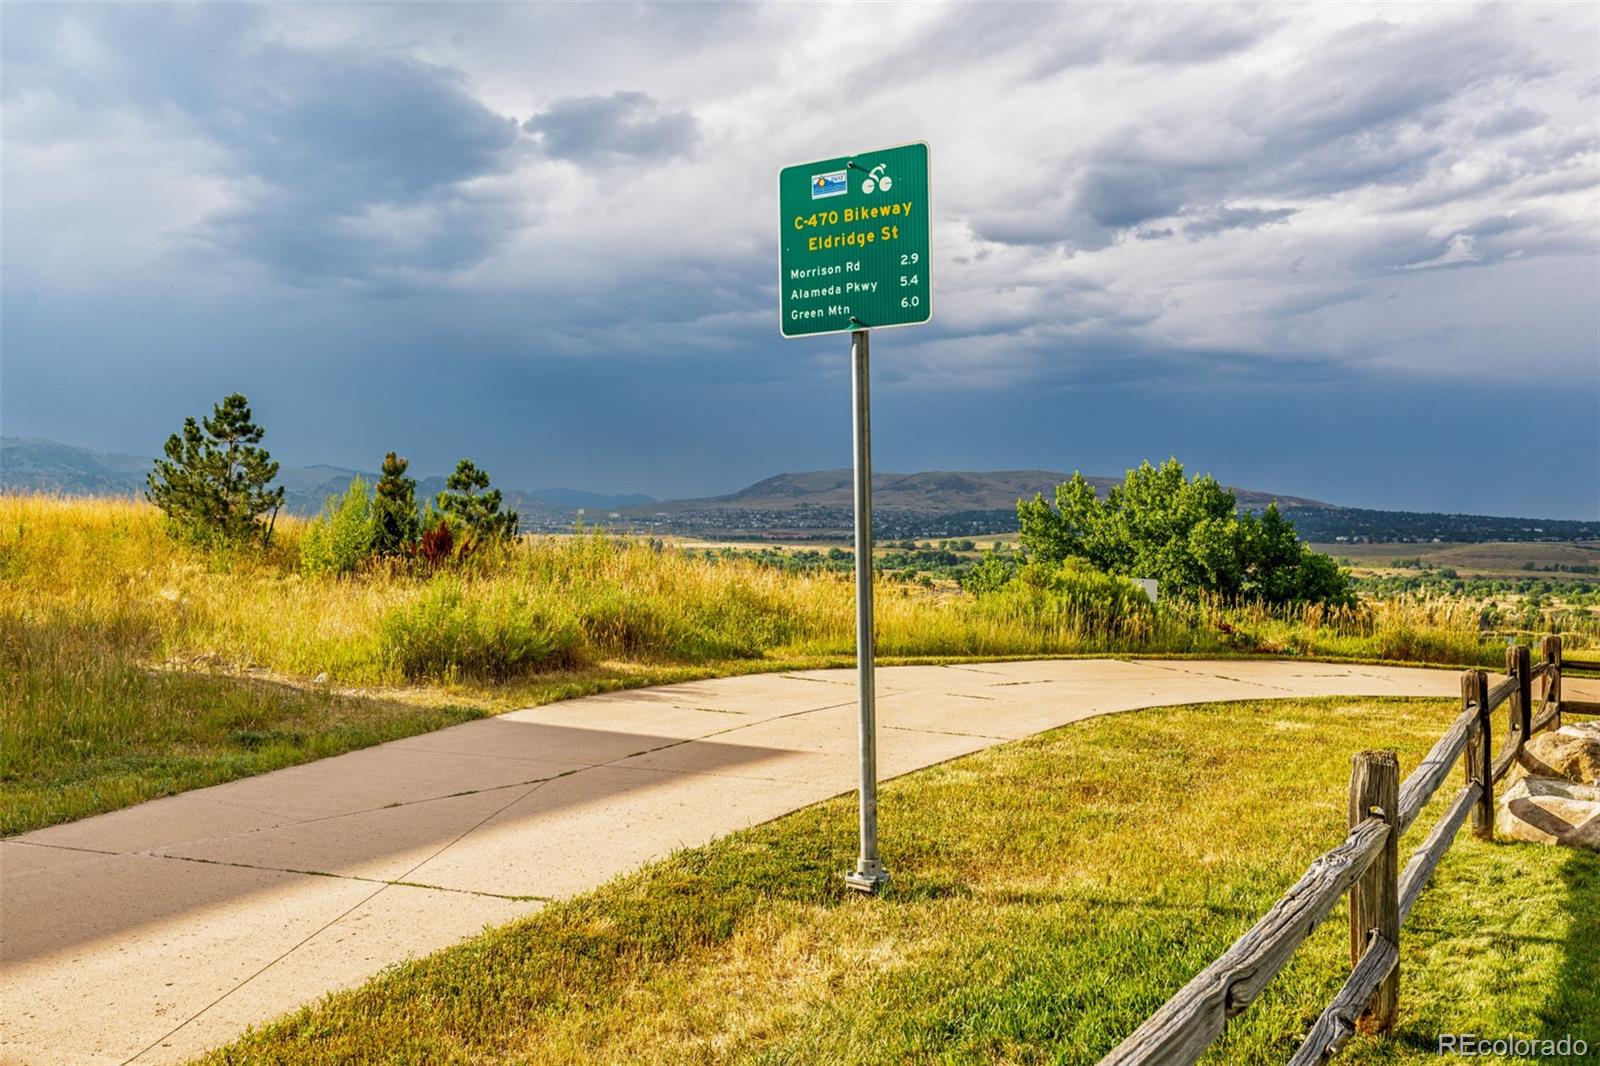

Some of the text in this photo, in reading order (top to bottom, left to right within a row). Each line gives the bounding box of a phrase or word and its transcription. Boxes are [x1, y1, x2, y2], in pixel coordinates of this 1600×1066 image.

[794, 201, 912, 230] C-470 Bikeway
[808, 225, 899, 251] Eldridge St
[790, 253, 919, 279] Morrison Rd 2.9
[791, 275, 919, 300] Alameda Pkwy 5.4
[791, 296, 919, 320] Green Mtn 6.0
